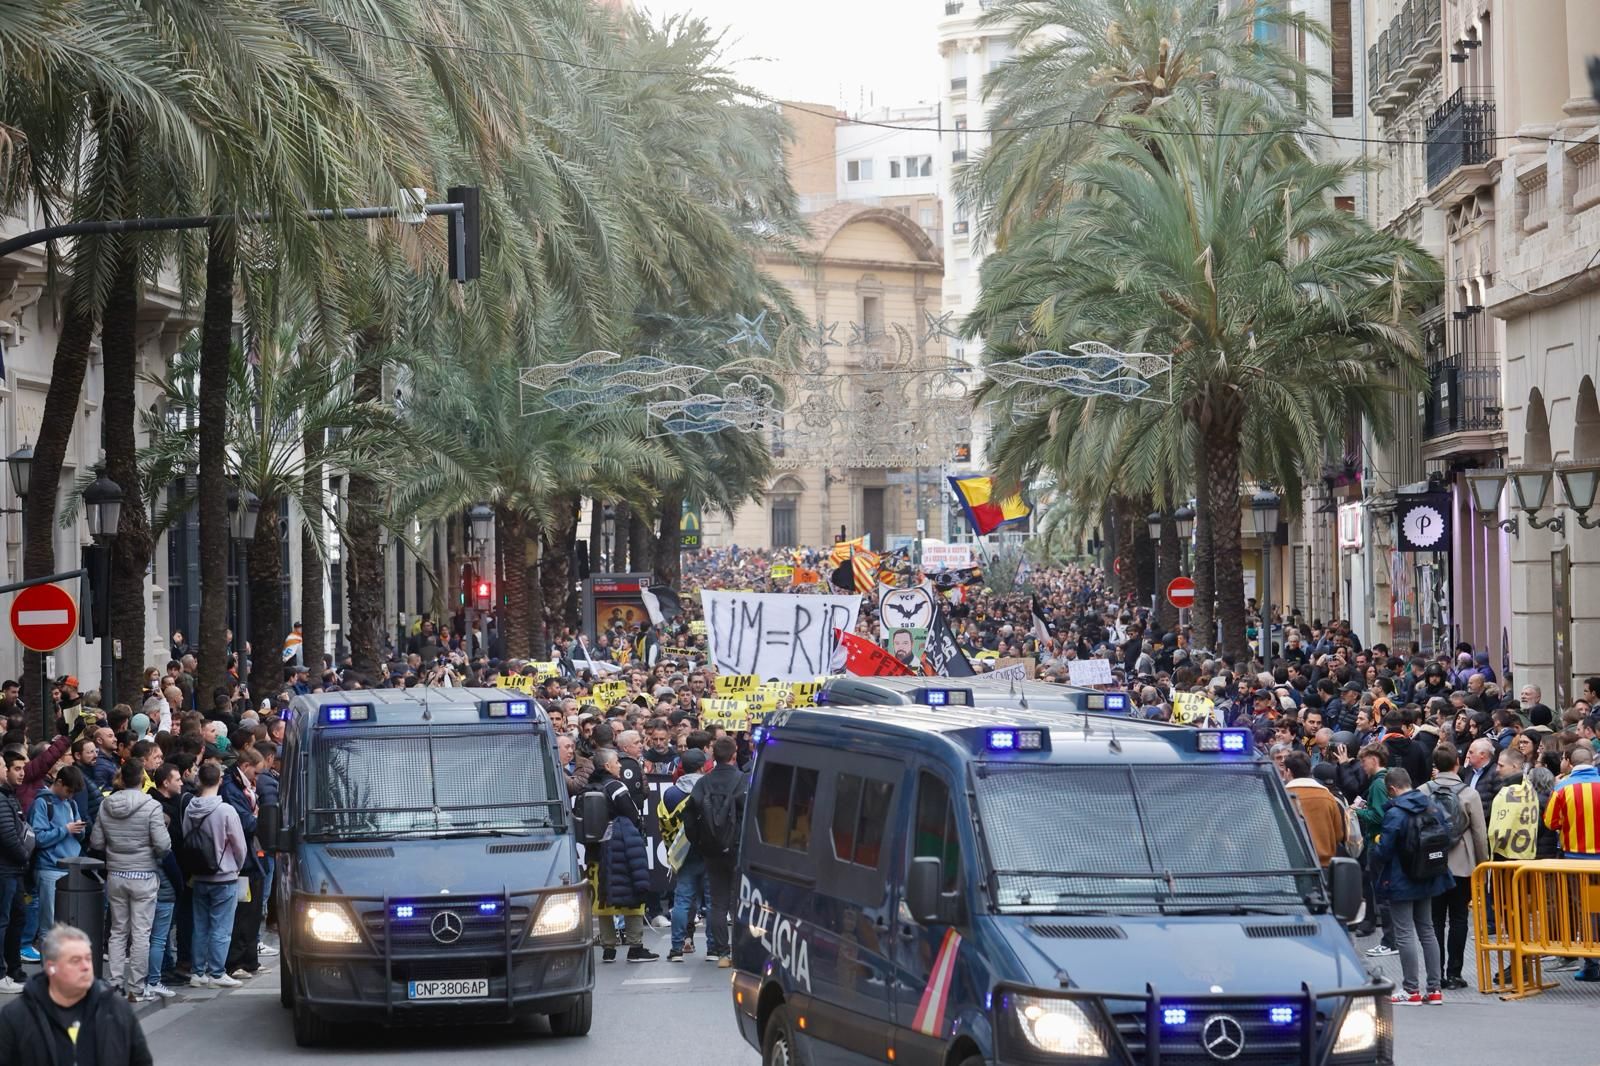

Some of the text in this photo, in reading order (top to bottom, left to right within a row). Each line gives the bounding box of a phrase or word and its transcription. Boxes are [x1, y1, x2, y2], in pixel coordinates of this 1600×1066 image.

[504, 677, 527, 687] LIM
[724, 675, 752, 688] LIM
[599, 682, 619, 693] LIM
[745, 693, 765, 703] LIM
[1178, 693, 1205, 705] LIM
[710, 700, 739, 710] LIM
[717, 710, 733, 718] GO
[1520, 805, 1539, 825] GO
[737, 873, 812, 993] POLICÍA
[416, 981, 487, 996] CNP3806AP
